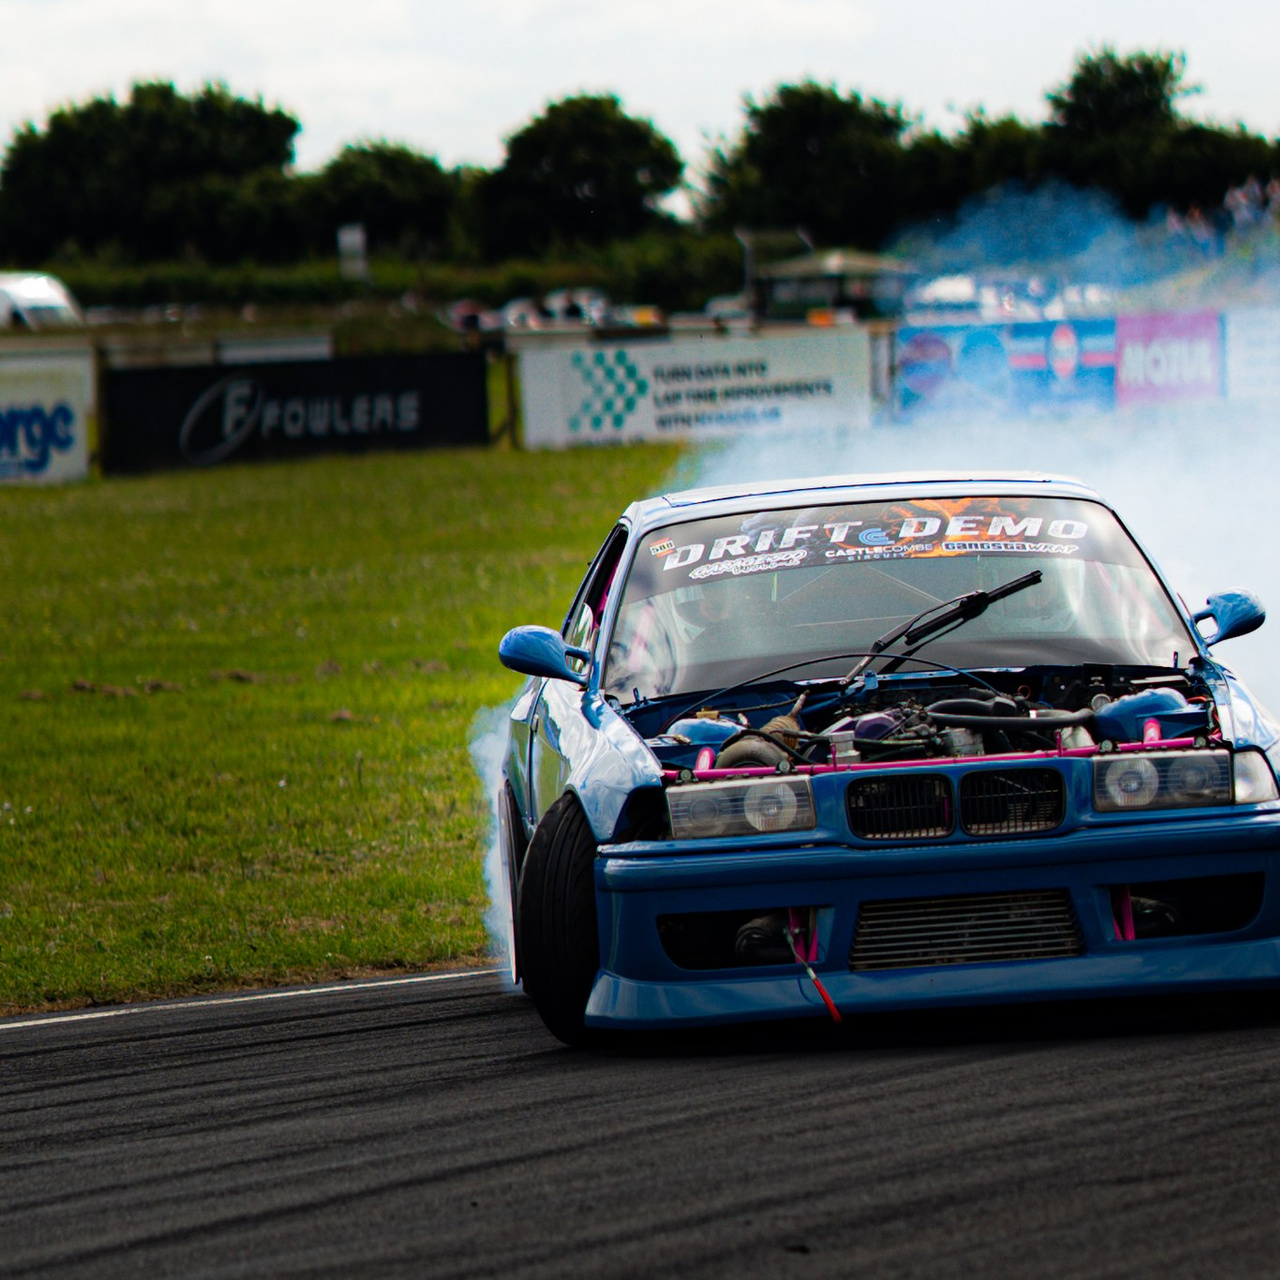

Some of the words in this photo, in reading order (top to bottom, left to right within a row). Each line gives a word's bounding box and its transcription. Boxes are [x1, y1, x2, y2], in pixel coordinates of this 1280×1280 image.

[1120, 339, 1213, 384] MOTUL
[262, 393, 419, 438] FOWLERS
[663, 521, 862, 571] DRIFT
[899, 517, 1088, 539] DEMO
[825, 543, 933, 558] CASTLECOMBE
[848, 552, 906, 560] CIRCUIT
